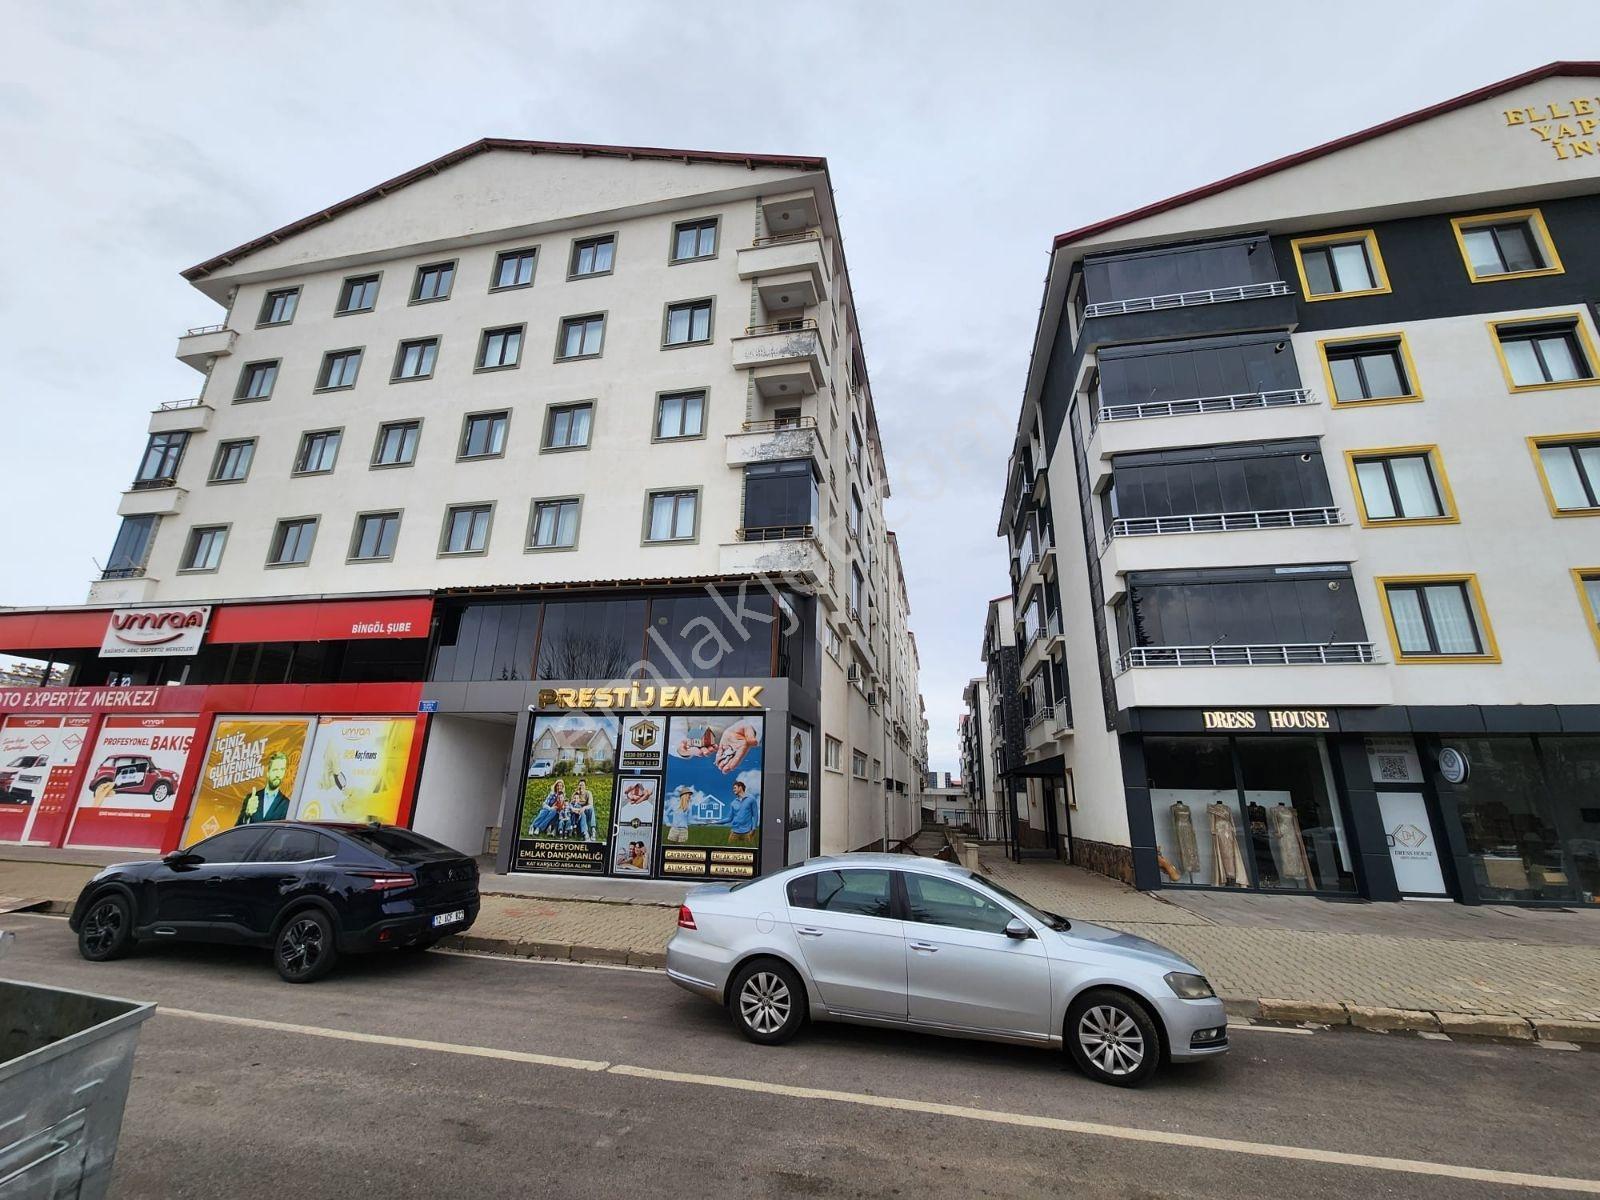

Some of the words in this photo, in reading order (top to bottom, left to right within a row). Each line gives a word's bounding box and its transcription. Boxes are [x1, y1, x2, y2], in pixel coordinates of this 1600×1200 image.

[1503, 97, 1600, 126] ELLE
[1530, 118, 1600, 142] YAP
[1552, 138, 1600, 160] İN
[351, 621, 385, 634] BİNGÖL
[387, 622, 412, 635] ŞUBE
[0, 691, 21, 706] TO
[23, 688, 91, 706] EXPERTİZ
[91, 687, 160, 706] MERKEZİ
[538, 681, 655, 709] PRESTİJ
[659, 686, 764, 709] EMLAK
[1202, 711, 1257, 729] DRESS
[1268, 711, 1330, 729] HOUSE
[103, 737, 150, 747] PROFESYONEL
[150, 735, 193, 754] BAKIŞ
[223, 737, 269, 764] RAHAT
[212, 773, 233, 789] TAM
[234, 765, 265, 784] OLSUN
[519, 850, 546, 858] EMLAK
[547, 851, 603, 861] DANIŞMANLIĞI
[535, 842, 589, 851] PROFESYONEL
